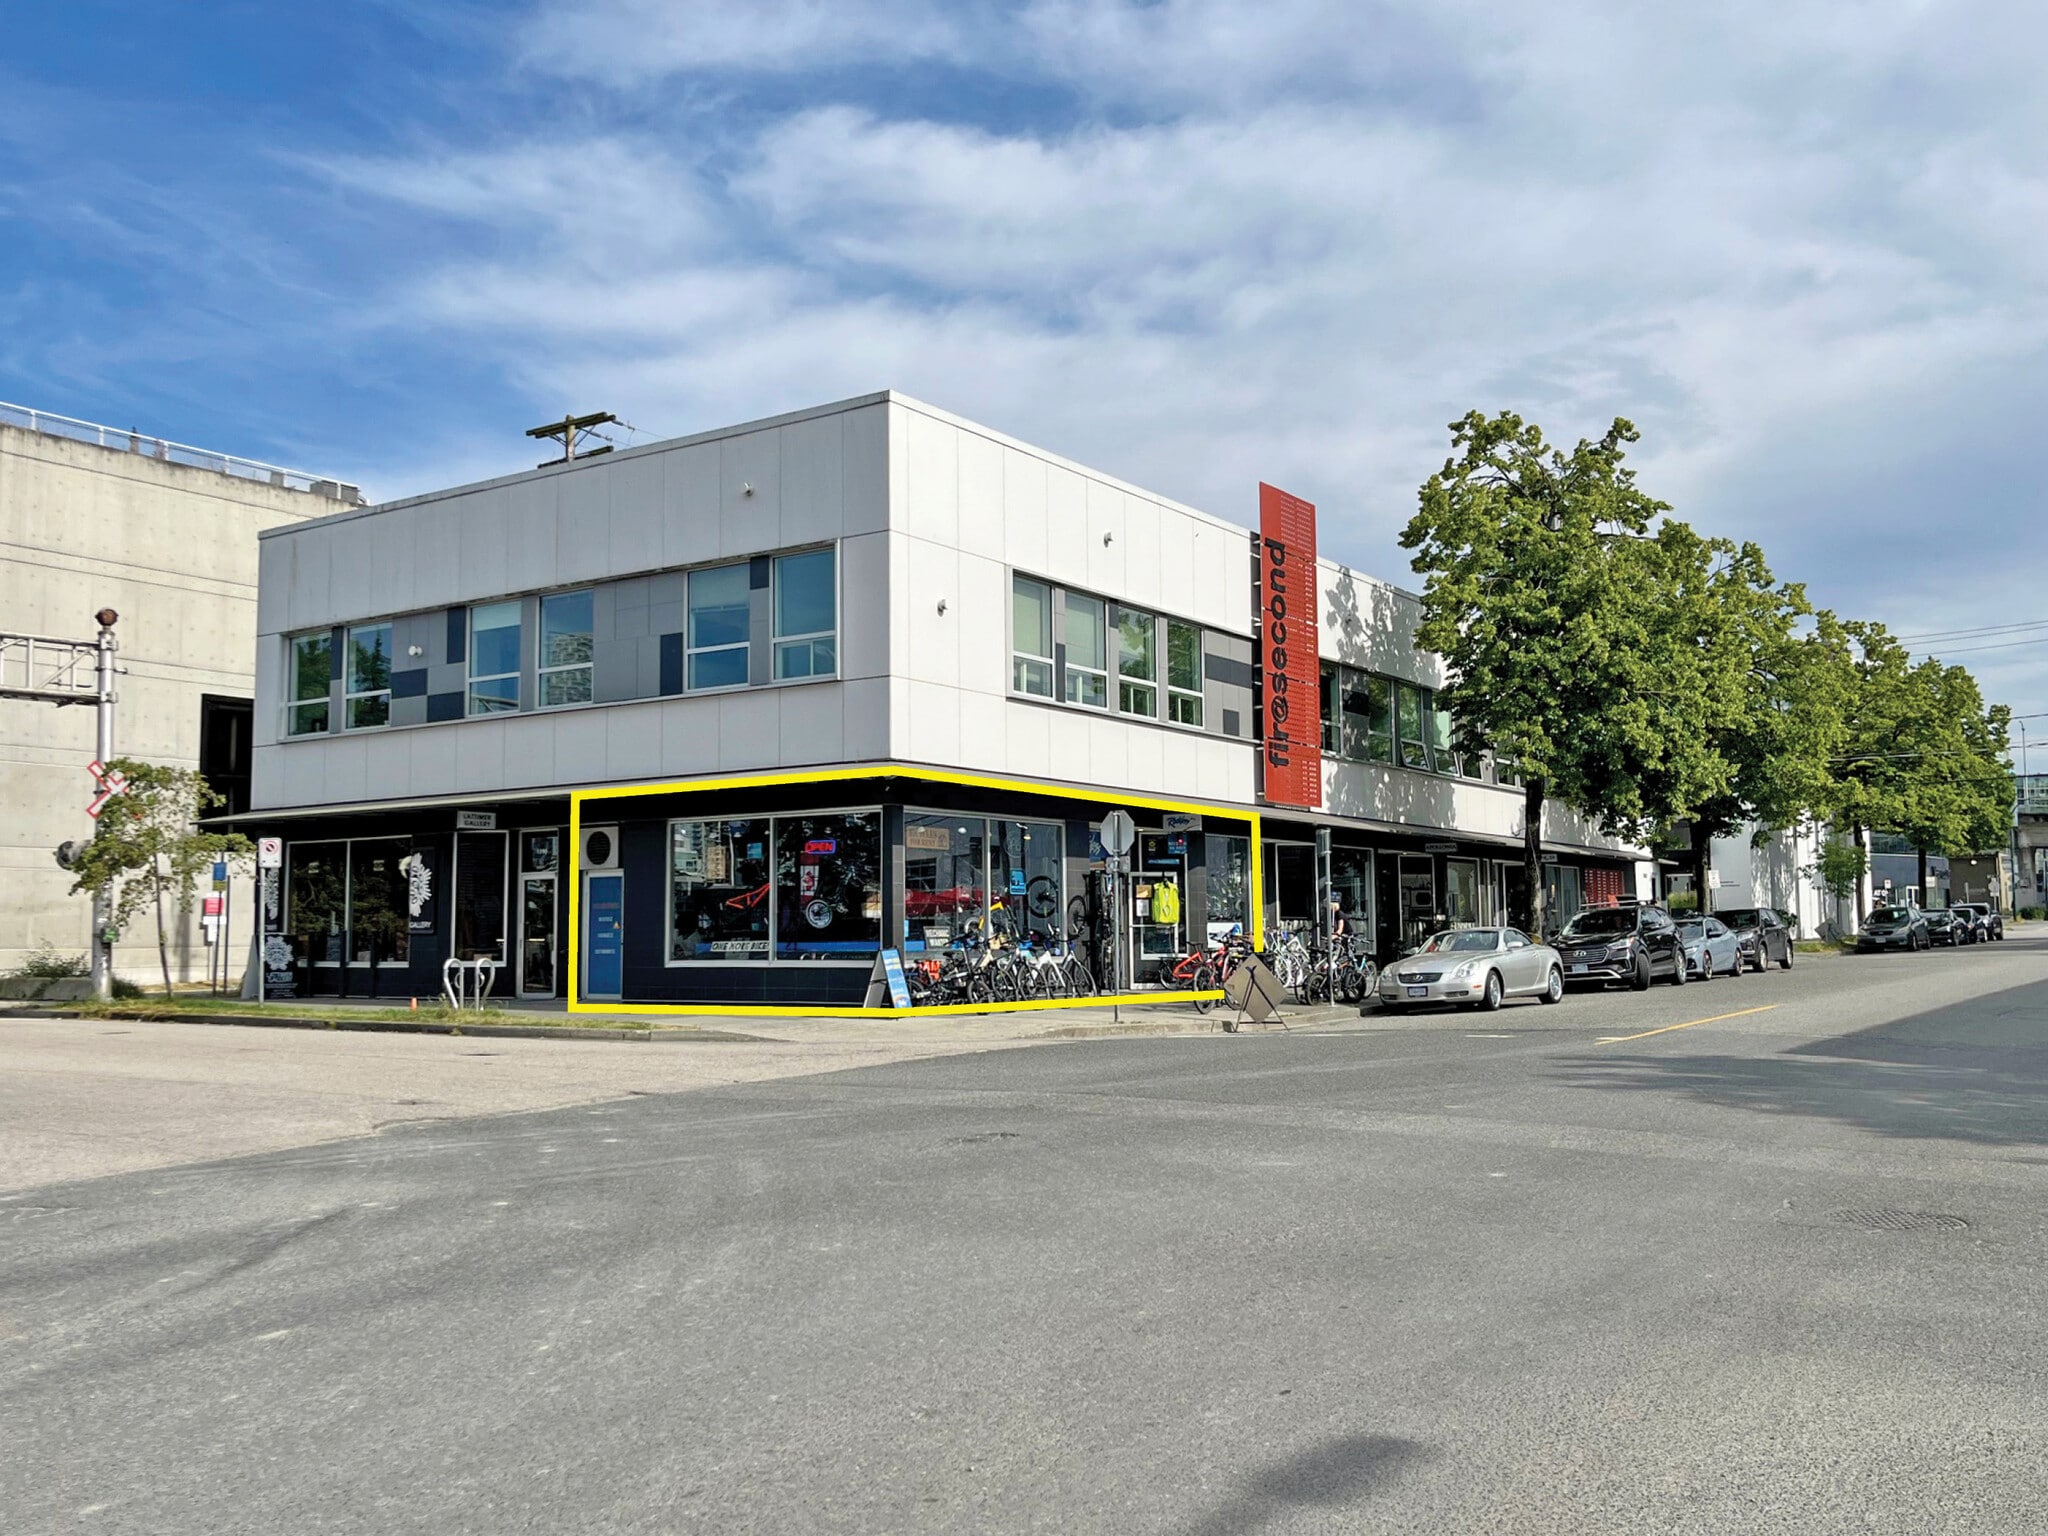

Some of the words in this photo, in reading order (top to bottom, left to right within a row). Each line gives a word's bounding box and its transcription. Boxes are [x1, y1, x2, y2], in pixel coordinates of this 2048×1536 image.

[805, 842, 833, 852] OPEN
[409, 921, 432, 929] GALLERY
[712, 942, 728, 950] ONE
[730, 942, 750, 950] MORE
